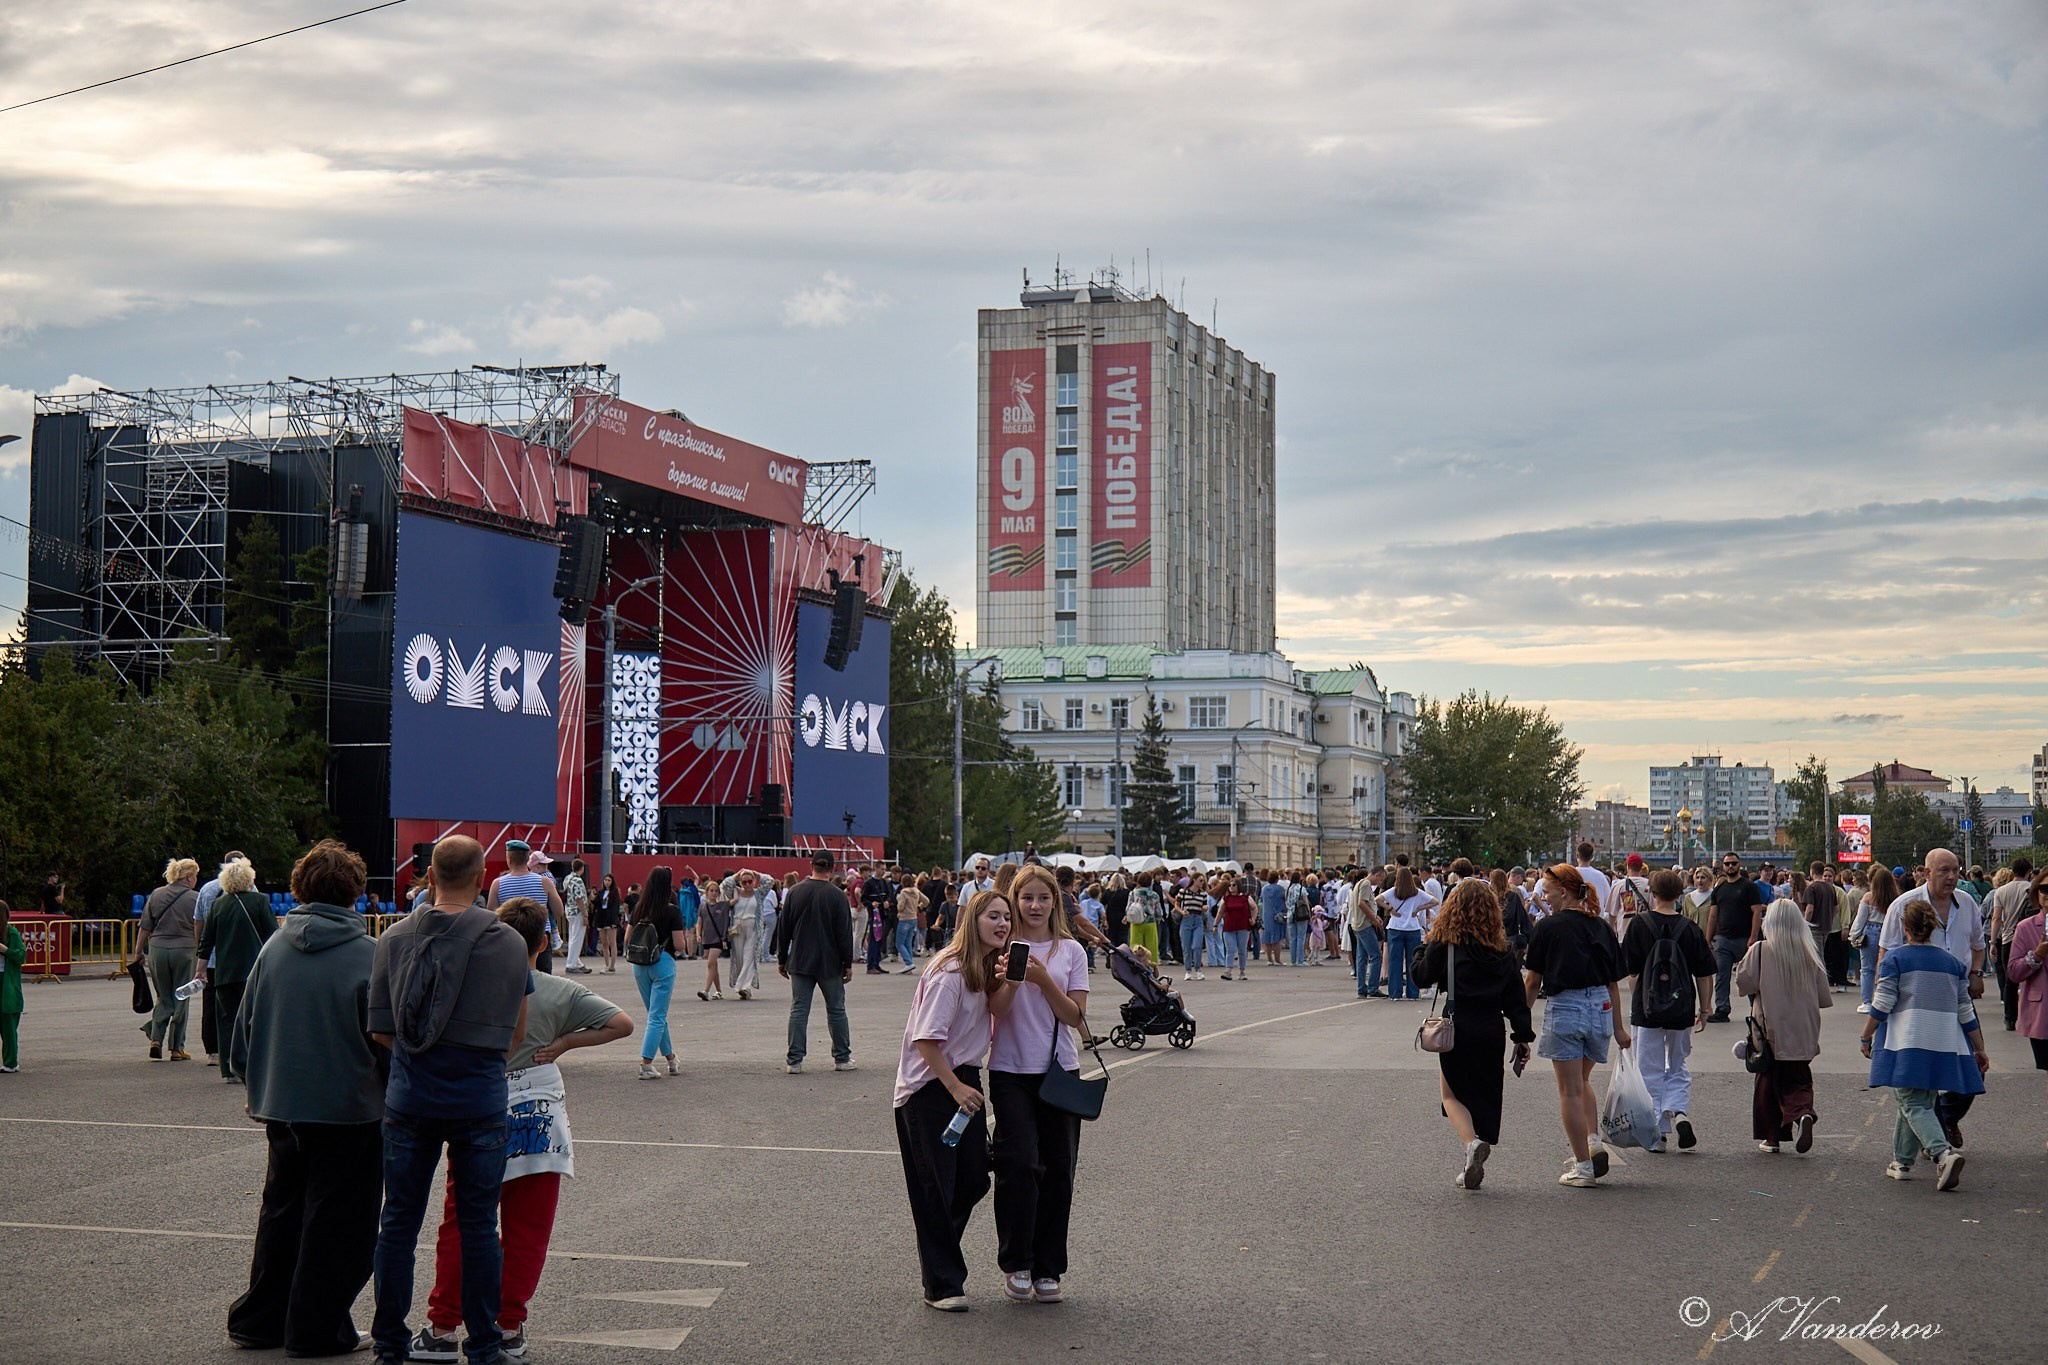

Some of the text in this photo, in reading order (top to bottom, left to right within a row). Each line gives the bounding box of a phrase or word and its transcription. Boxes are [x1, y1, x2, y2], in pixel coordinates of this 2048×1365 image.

[1002, 424, 1036, 435] ПОБЕДА!
[1003, 406, 1022, 423] 80
[643, 415, 726, 463] С праздником,
[1105, 366, 1142, 529] ПОБЕДА!
[667, 460, 750, 502] дорогие омичи!
[768, 459, 801, 488] ОМСК
[1002, 447, 1036, 512] 9
[1001, 516, 1036, 534] МАЯ
[403, 633, 554, 717] ОМСК
[800, 693, 886, 755] ОМСК
